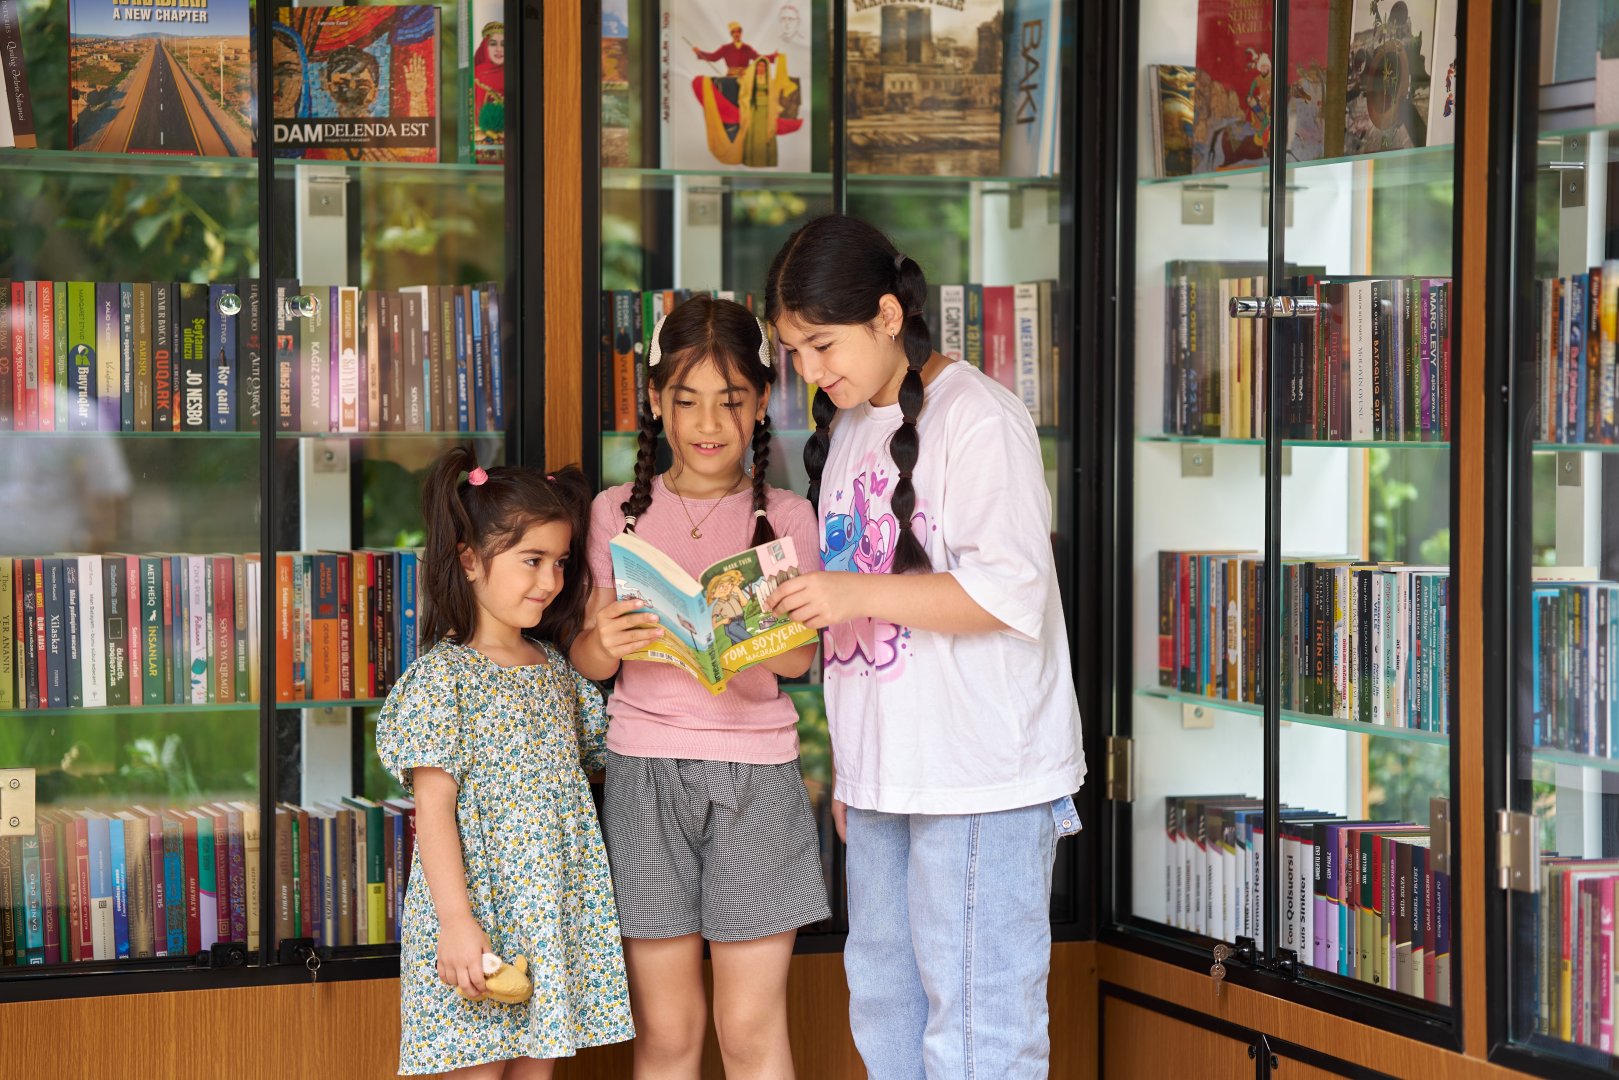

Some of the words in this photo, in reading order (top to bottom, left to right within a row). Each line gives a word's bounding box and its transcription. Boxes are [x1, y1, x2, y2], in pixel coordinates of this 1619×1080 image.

[113, 8, 120, 20] A
[125, 8, 151, 21] NEW
[156, 9, 208, 23] CHAPTER
[1016, 19, 1043, 125] BAKI
[324, 124, 397, 137] DELENDA
[401, 123, 429, 136] EST
[183, 328, 193, 360] ulduzu
[192, 318, 206, 360] Şeytanın
[311, 340, 322, 372] KAĞIZ
[76, 366, 90, 418] Buyruqlar
[155, 350, 169, 410] QUQARK
[186, 369, 203, 386] JO
[217, 365, 231, 387] Kor
[311, 373, 320, 408] SARAY
[186, 388, 203, 425] NESBO
[216, 388, 230, 415] qatil
[148, 563, 156, 585] METT
[723, 562, 738, 572] MARK
[146, 586, 158, 607] HEİQ
[51, 613, 61, 655] Xilaskar
[147, 624, 160, 678] İNSANLAR
[723, 645, 748, 665] TOM
[1286, 855, 1295, 921] Qolsuorsi
